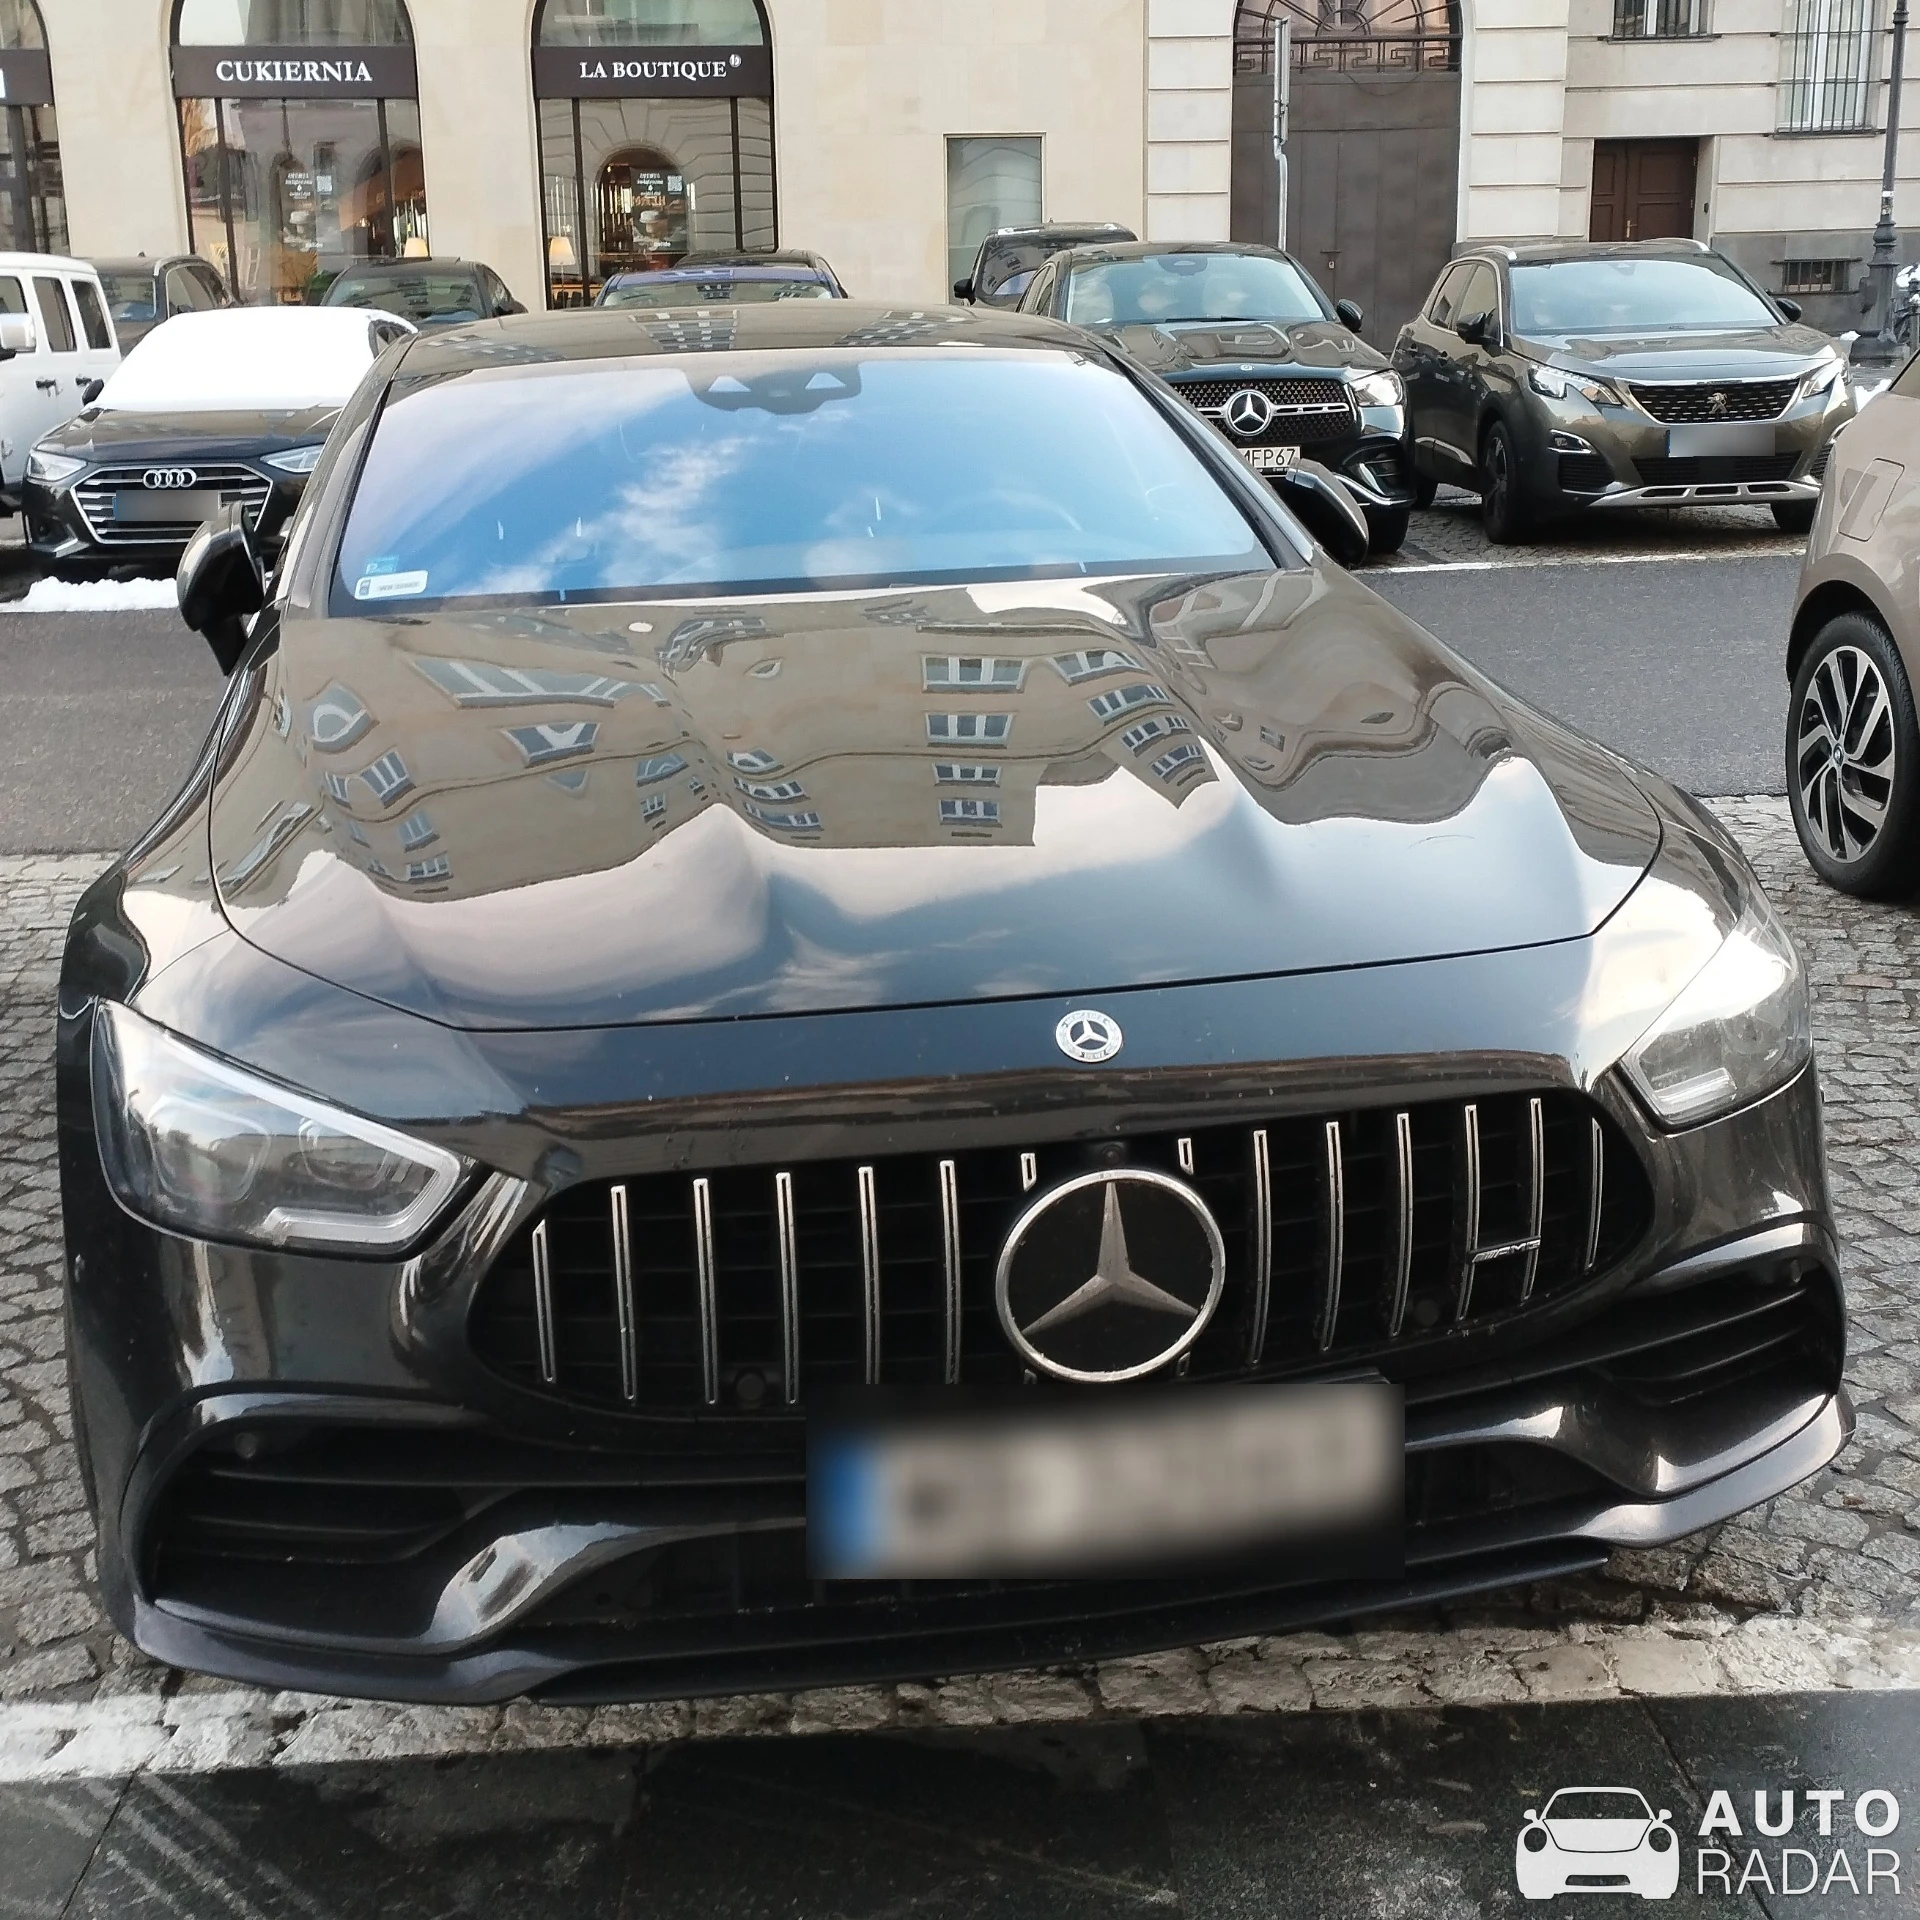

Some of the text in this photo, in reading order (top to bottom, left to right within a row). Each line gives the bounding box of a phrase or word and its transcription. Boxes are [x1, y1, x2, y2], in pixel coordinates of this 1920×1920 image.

[216, 60, 373, 82] CUKIERNIA
[579, 61, 607, 79] LA
[612, 60, 727, 81] BOUTIQUE
